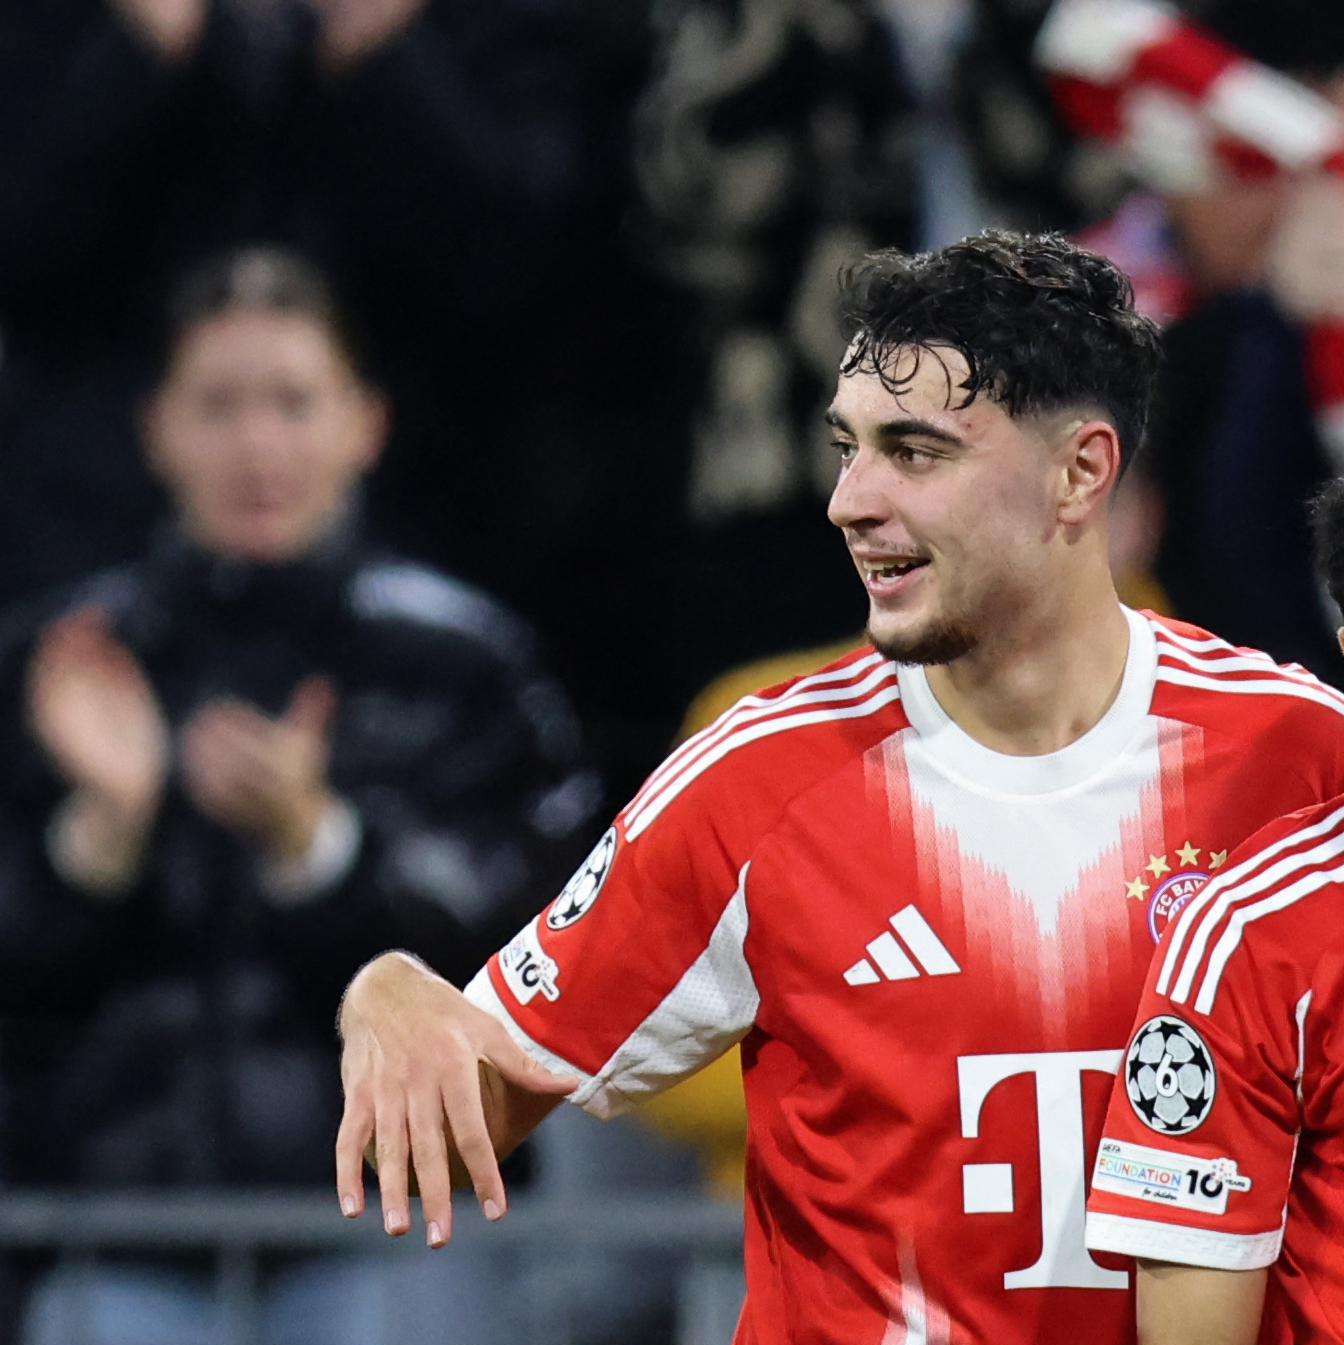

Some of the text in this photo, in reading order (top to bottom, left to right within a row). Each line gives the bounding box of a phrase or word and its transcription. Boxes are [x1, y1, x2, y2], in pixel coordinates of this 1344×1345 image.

[1155, 894, 1173, 916] FC
[1155, 1052, 1179, 1098] 6
[1102, 1143, 1121, 1153] UEFA
[1186, 1168, 1223, 1198] 10
